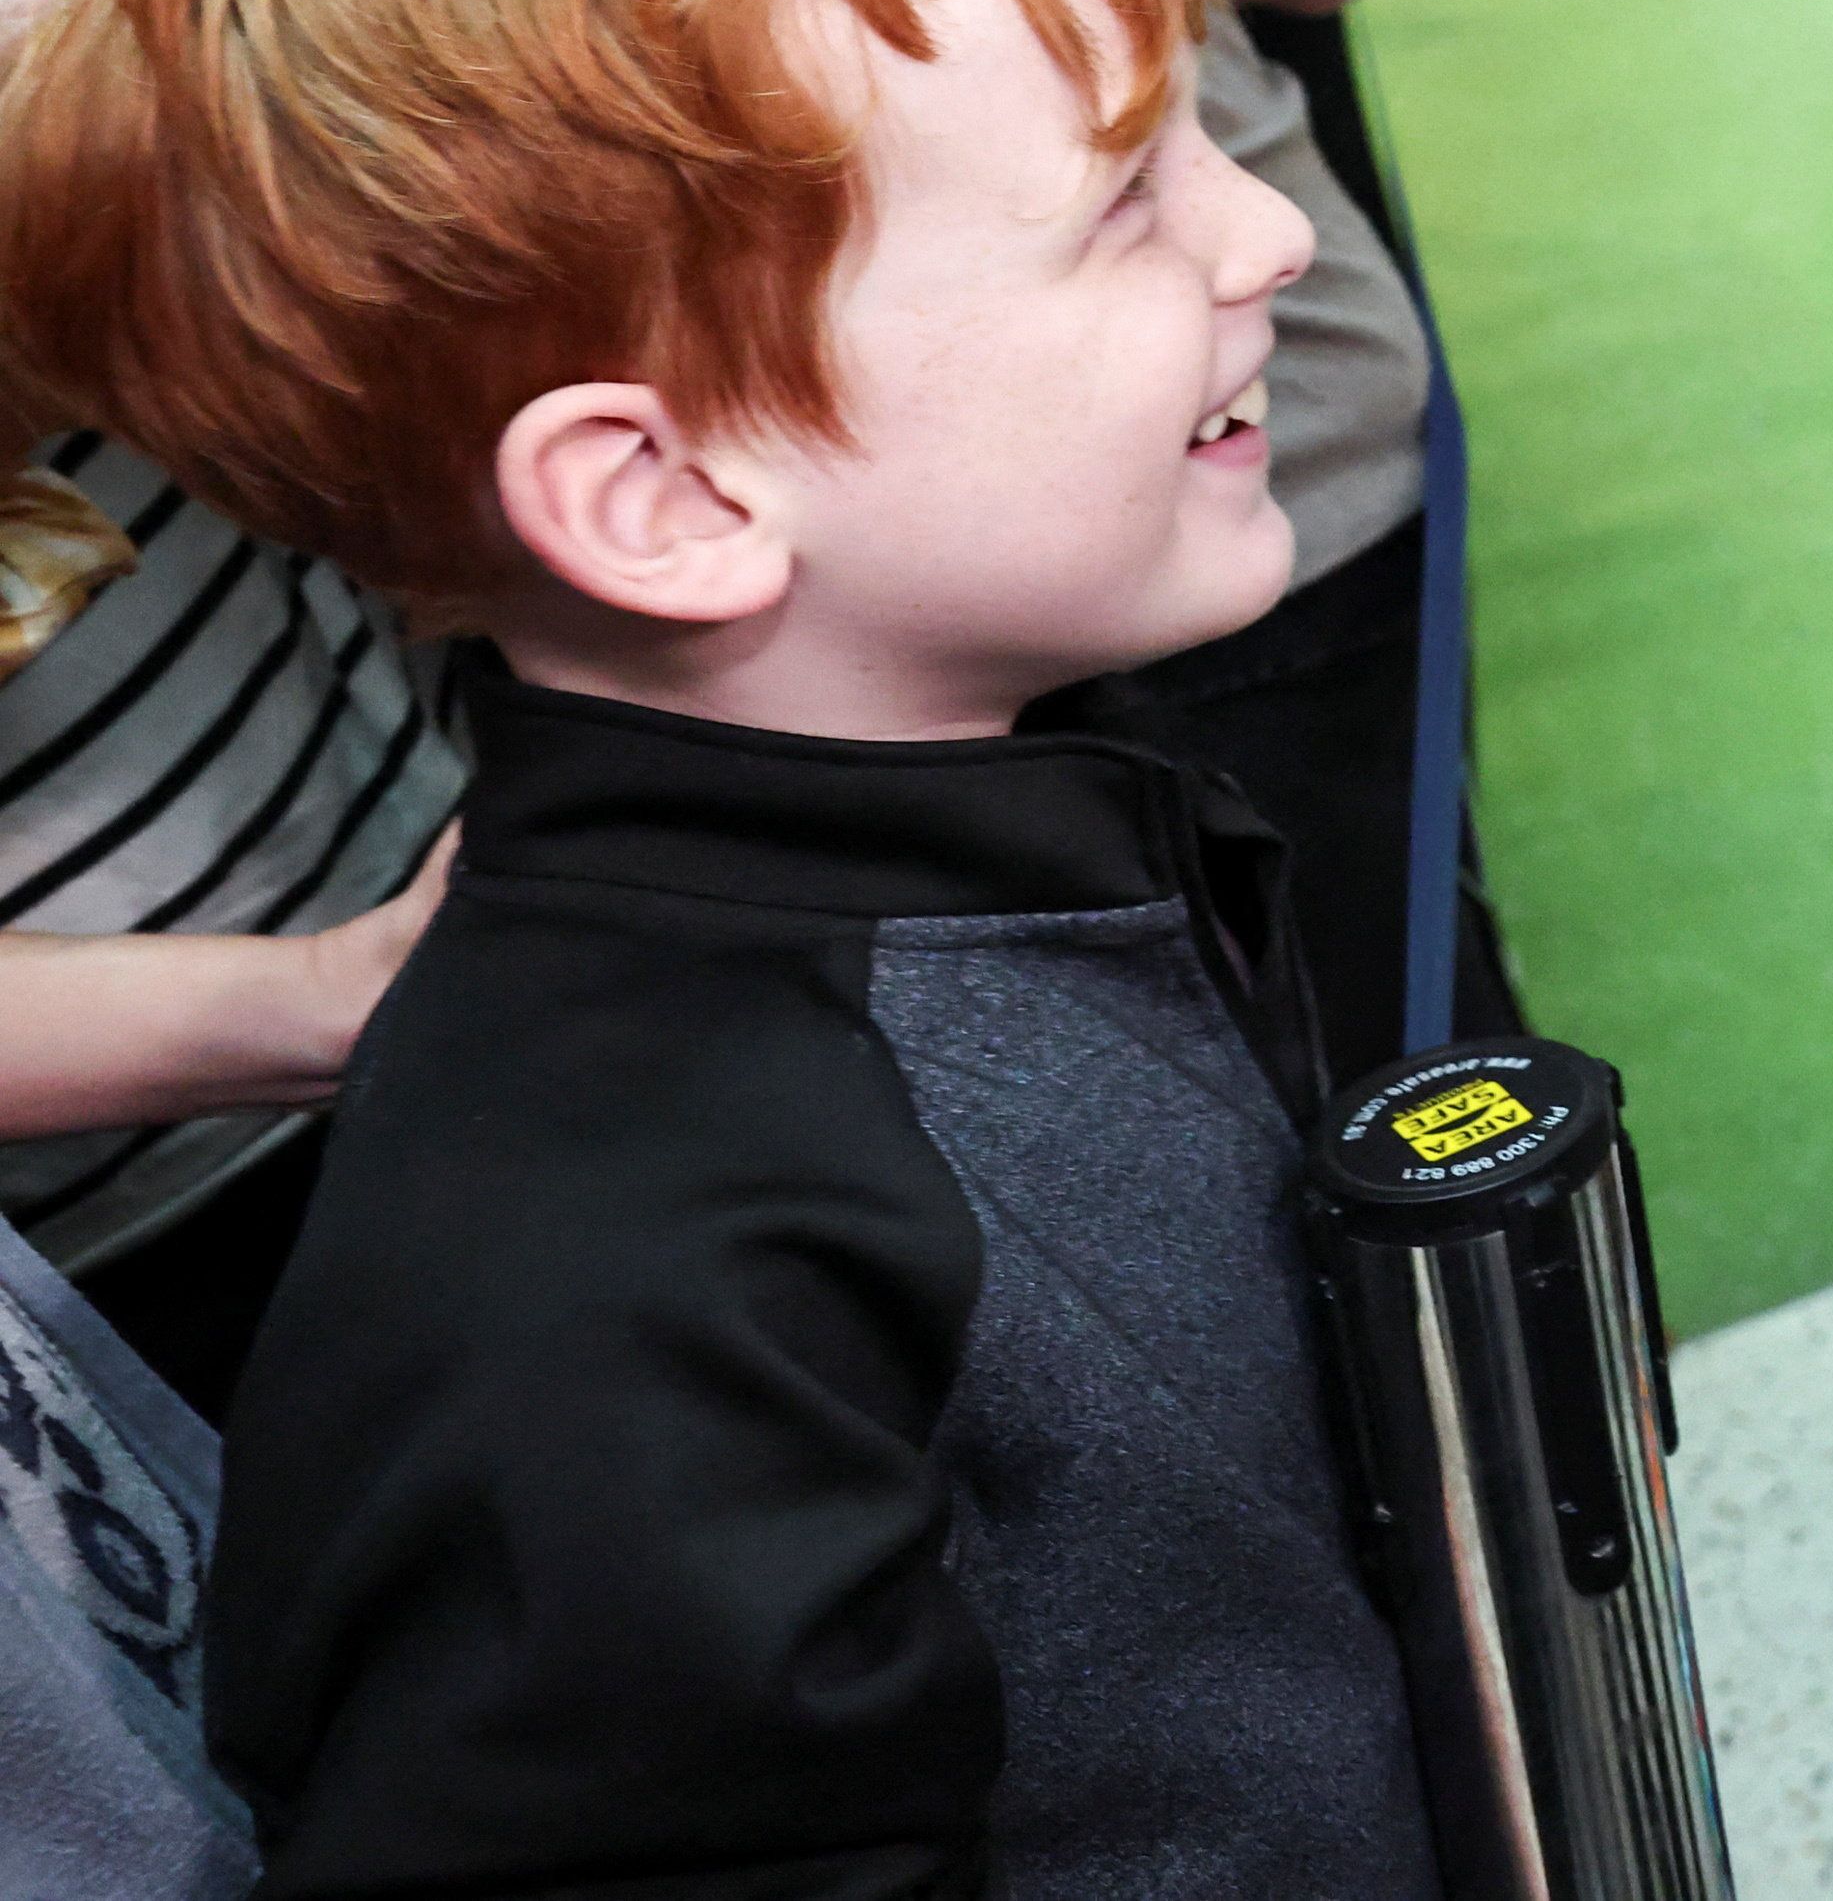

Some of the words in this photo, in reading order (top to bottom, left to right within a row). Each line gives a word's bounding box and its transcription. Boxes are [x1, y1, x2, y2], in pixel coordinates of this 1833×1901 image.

[1402, 1090, 1496, 1135] SAFE
[1424, 1109, 1518, 1156] AREA
[1496, 1132, 1546, 1161] 1300
[1450, 1156, 1496, 1177] 889
